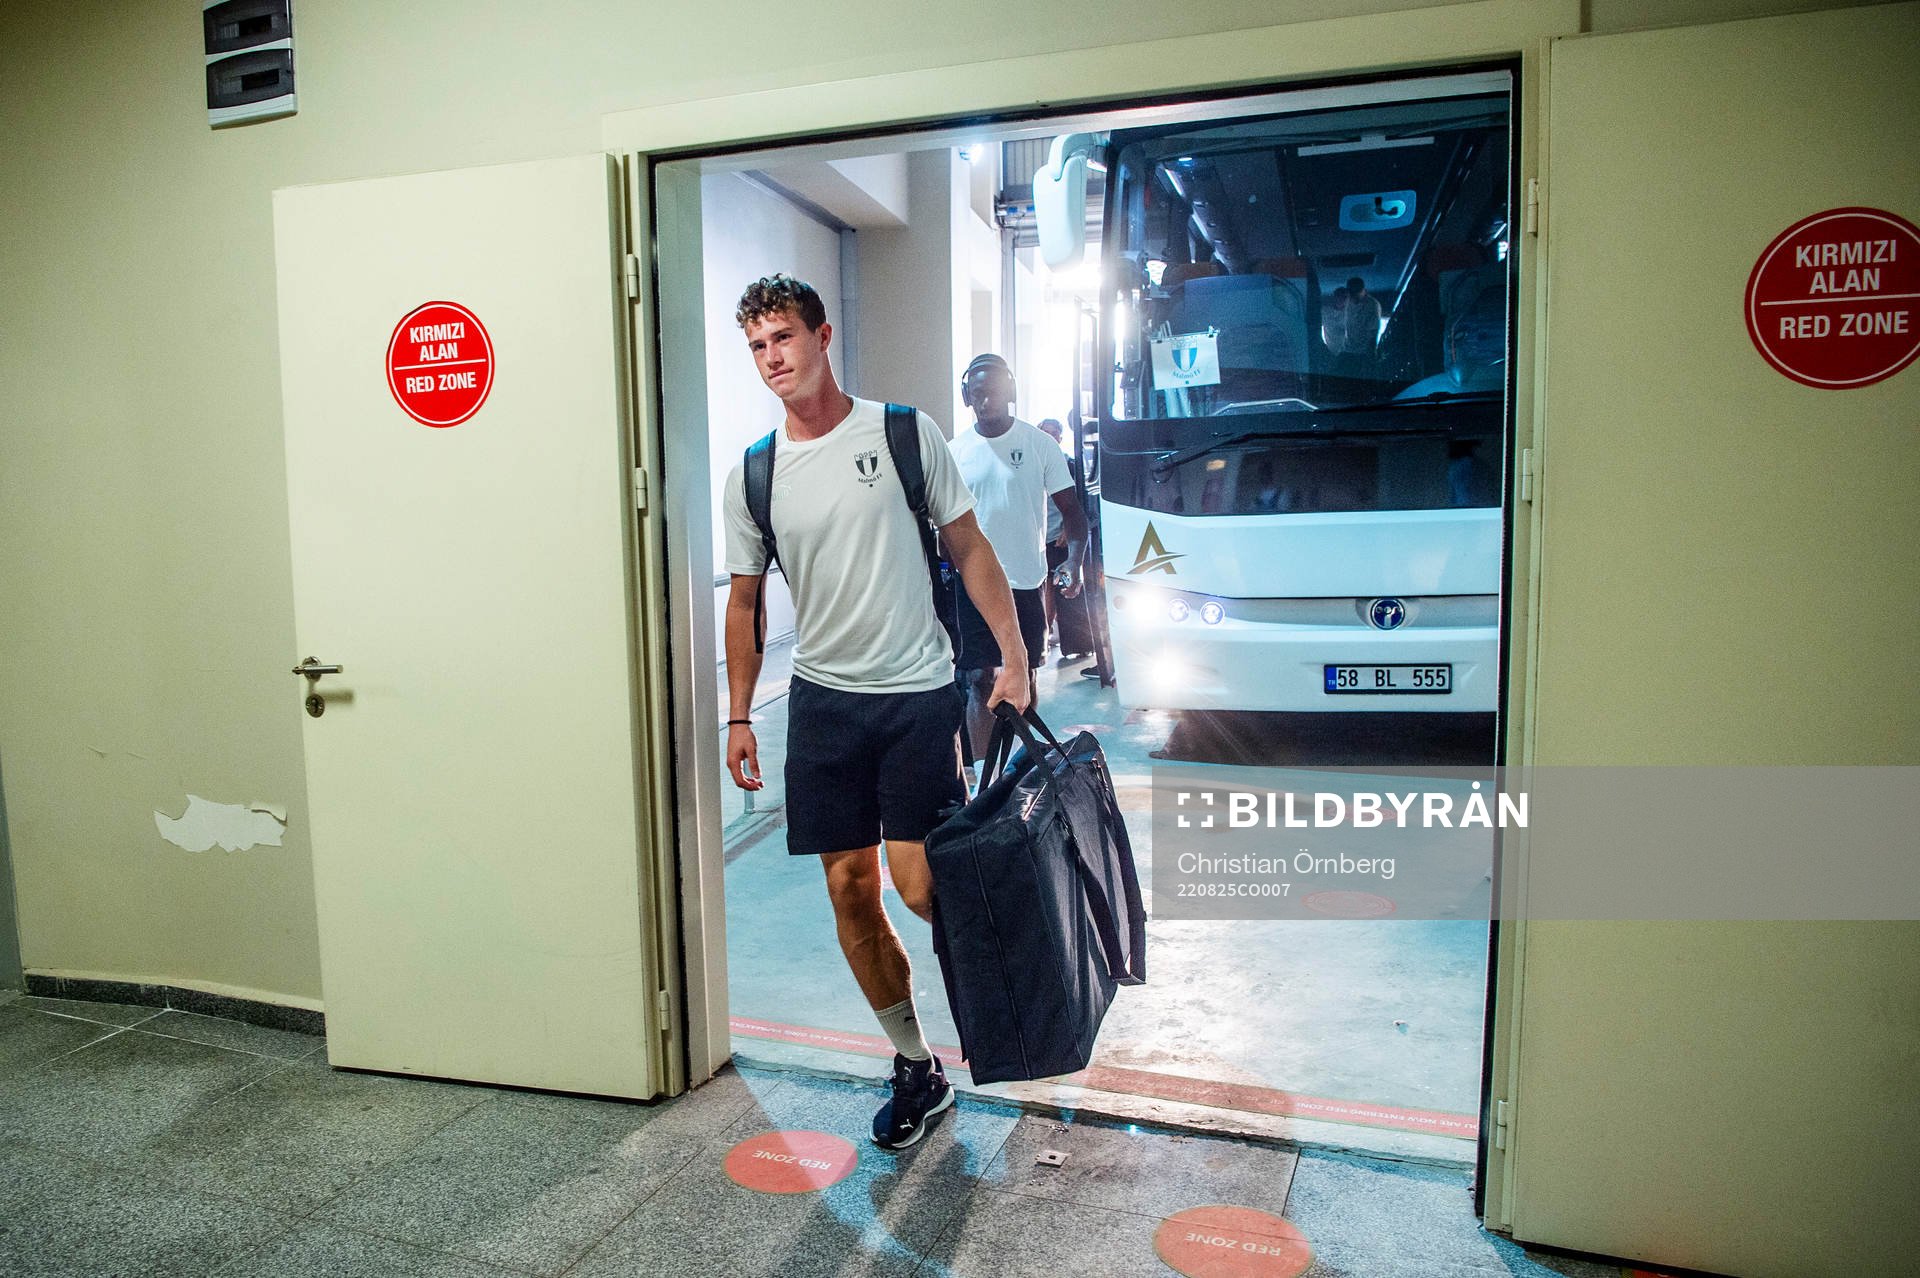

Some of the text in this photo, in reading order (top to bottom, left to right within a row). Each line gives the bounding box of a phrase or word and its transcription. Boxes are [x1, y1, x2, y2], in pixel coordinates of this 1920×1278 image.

[1796, 240, 1897, 268] KIRMIZI
[1809, 268, 1880, 294] ALAN
[410, 322, 465, 343] KIRMIZI
[1780, 311, 1909, 339] RED ZONE
[420, 342, 458, 361] ALAN
[406, 372, 477, 394] RED ZONE
[1337, 669, 1359, 687] 58
[1375, 669, 1397, 687] BL
[1412, 669, 1446, 687] 555
[1407, 1116, 1436, 1125] NOW
[752, 1150, 832, 1170] RED ZONE
[1185, 1232, 1281, 1256] RED ZONE
